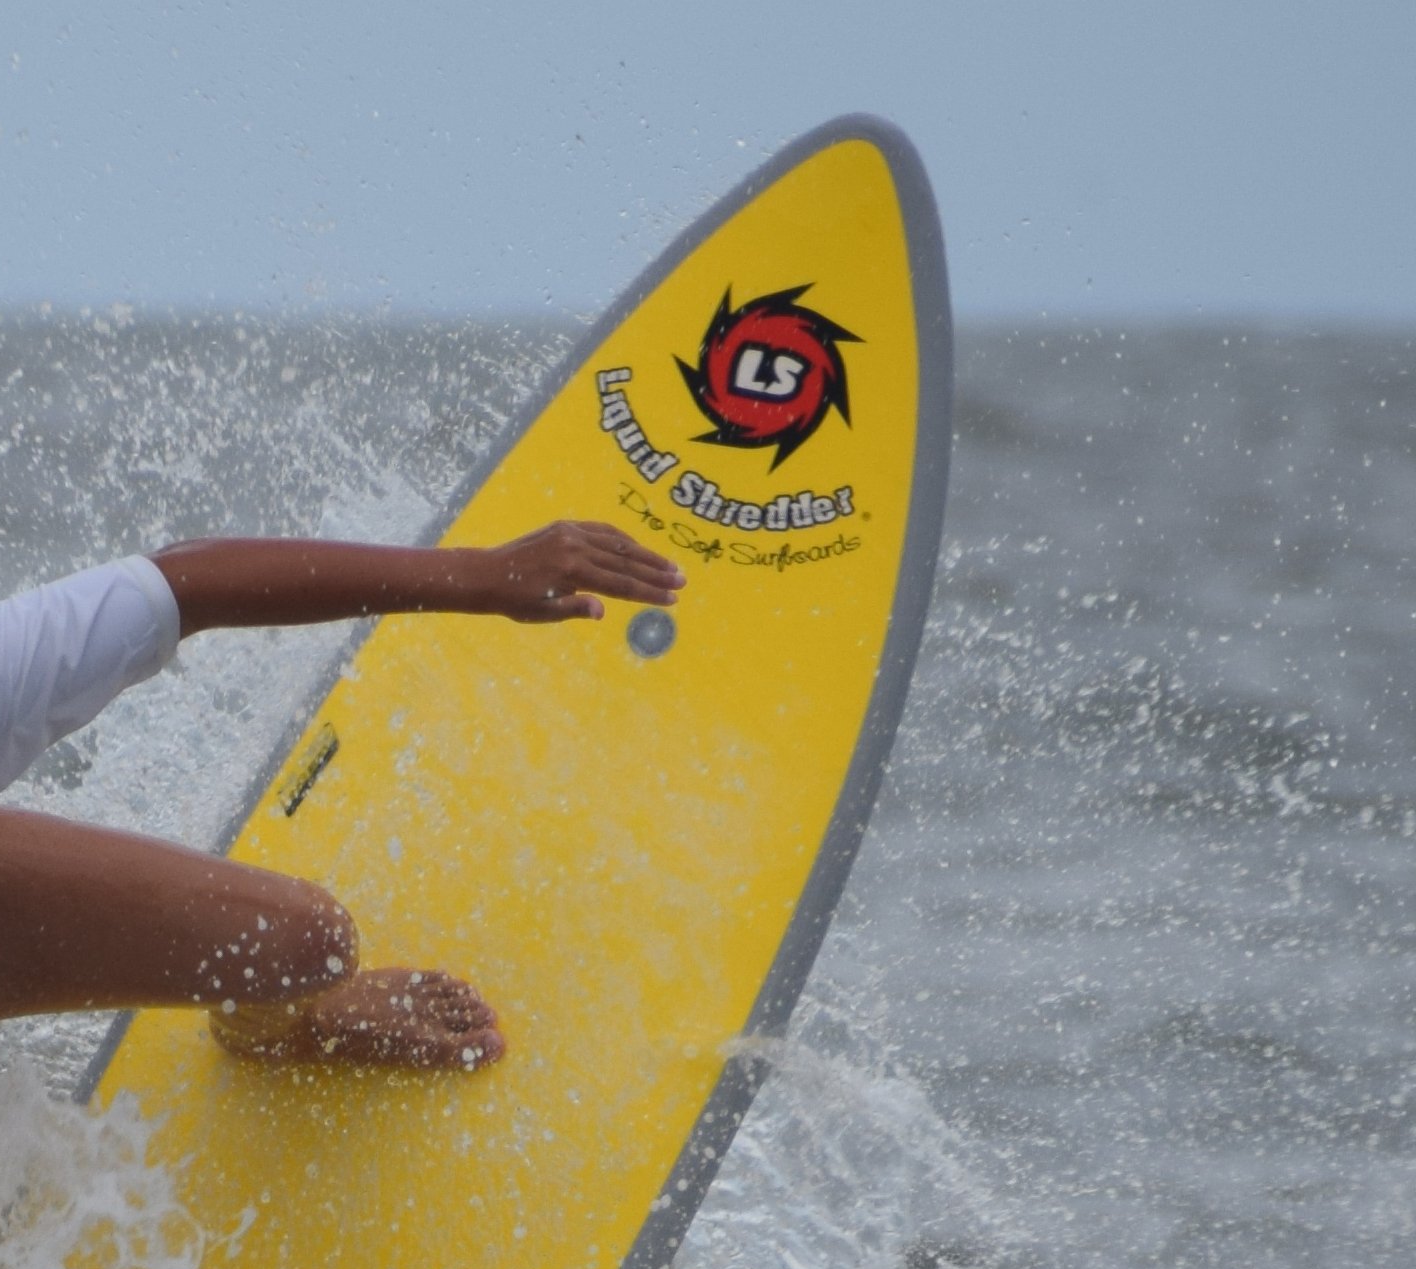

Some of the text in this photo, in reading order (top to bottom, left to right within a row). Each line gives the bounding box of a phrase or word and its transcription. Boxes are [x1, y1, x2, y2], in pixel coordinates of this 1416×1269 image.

[734, 347, 804, 398] LS
[595, 367, 856, 532] Liquid Shredder
[618, 482, 861, 573] Pro Soft Surfboards
